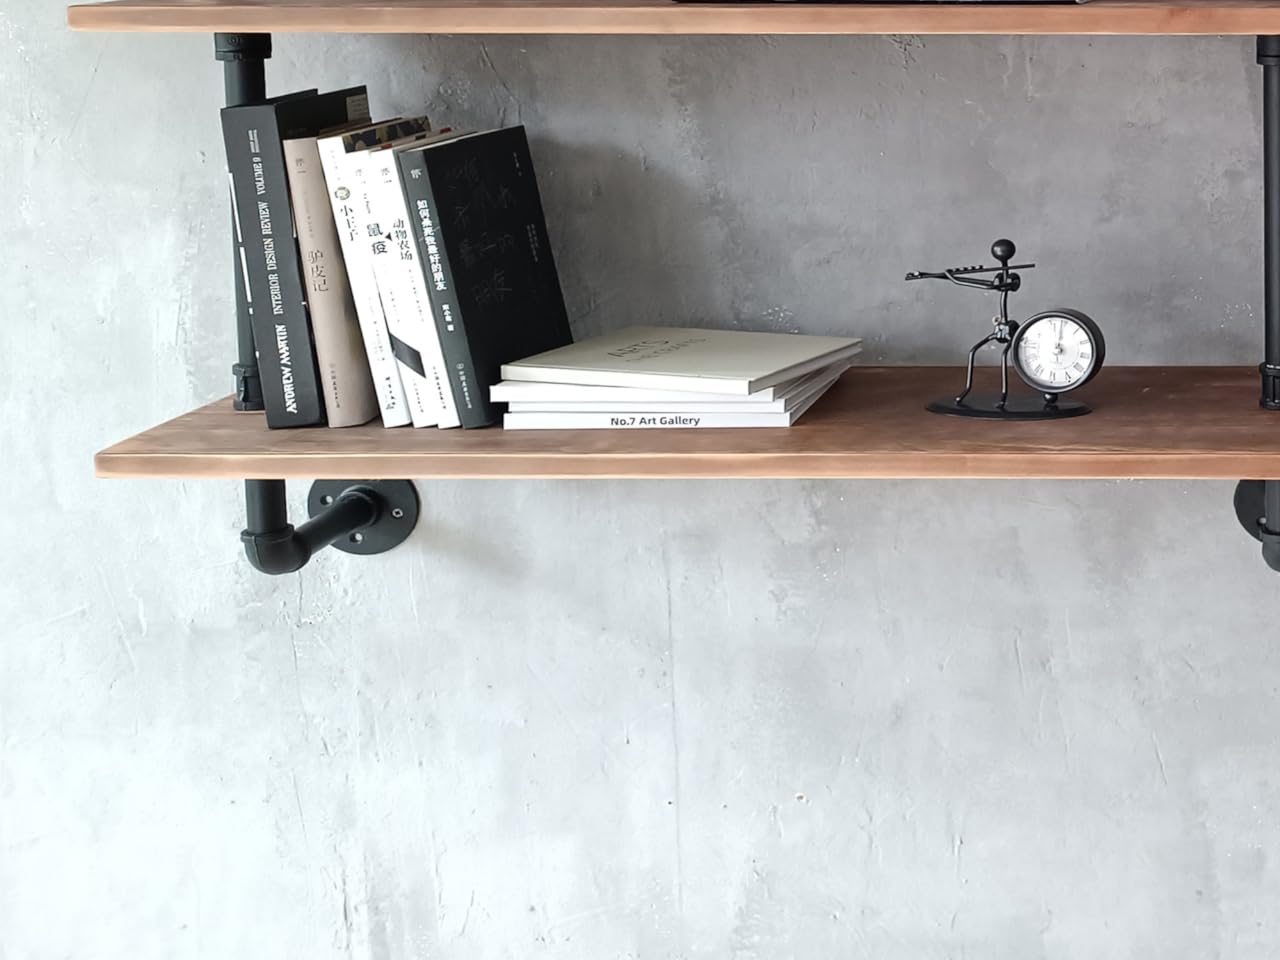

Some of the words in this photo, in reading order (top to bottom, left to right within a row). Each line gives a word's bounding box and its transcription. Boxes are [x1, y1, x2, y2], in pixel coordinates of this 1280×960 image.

[253, 163, 266, 195] VOLUME
[257, 201, 273, 235] REVIEW
[263, 238, 277, 270] DESIGN
[366, 223, 388, 255] 鼠疫
[393, 218, 413, 261] 动物农场
[308, 249, 329, 292] 驴皮记
[268, 273, 284, 315] INTERIOR
[274, 324, 292, 366] MARTIN
[280, 366, 298, 414] ANDREW
[610, 417, 636, 426] No.7
[639, 416, 657, 425] Art
[659, 415, 701, 427] Gallery
